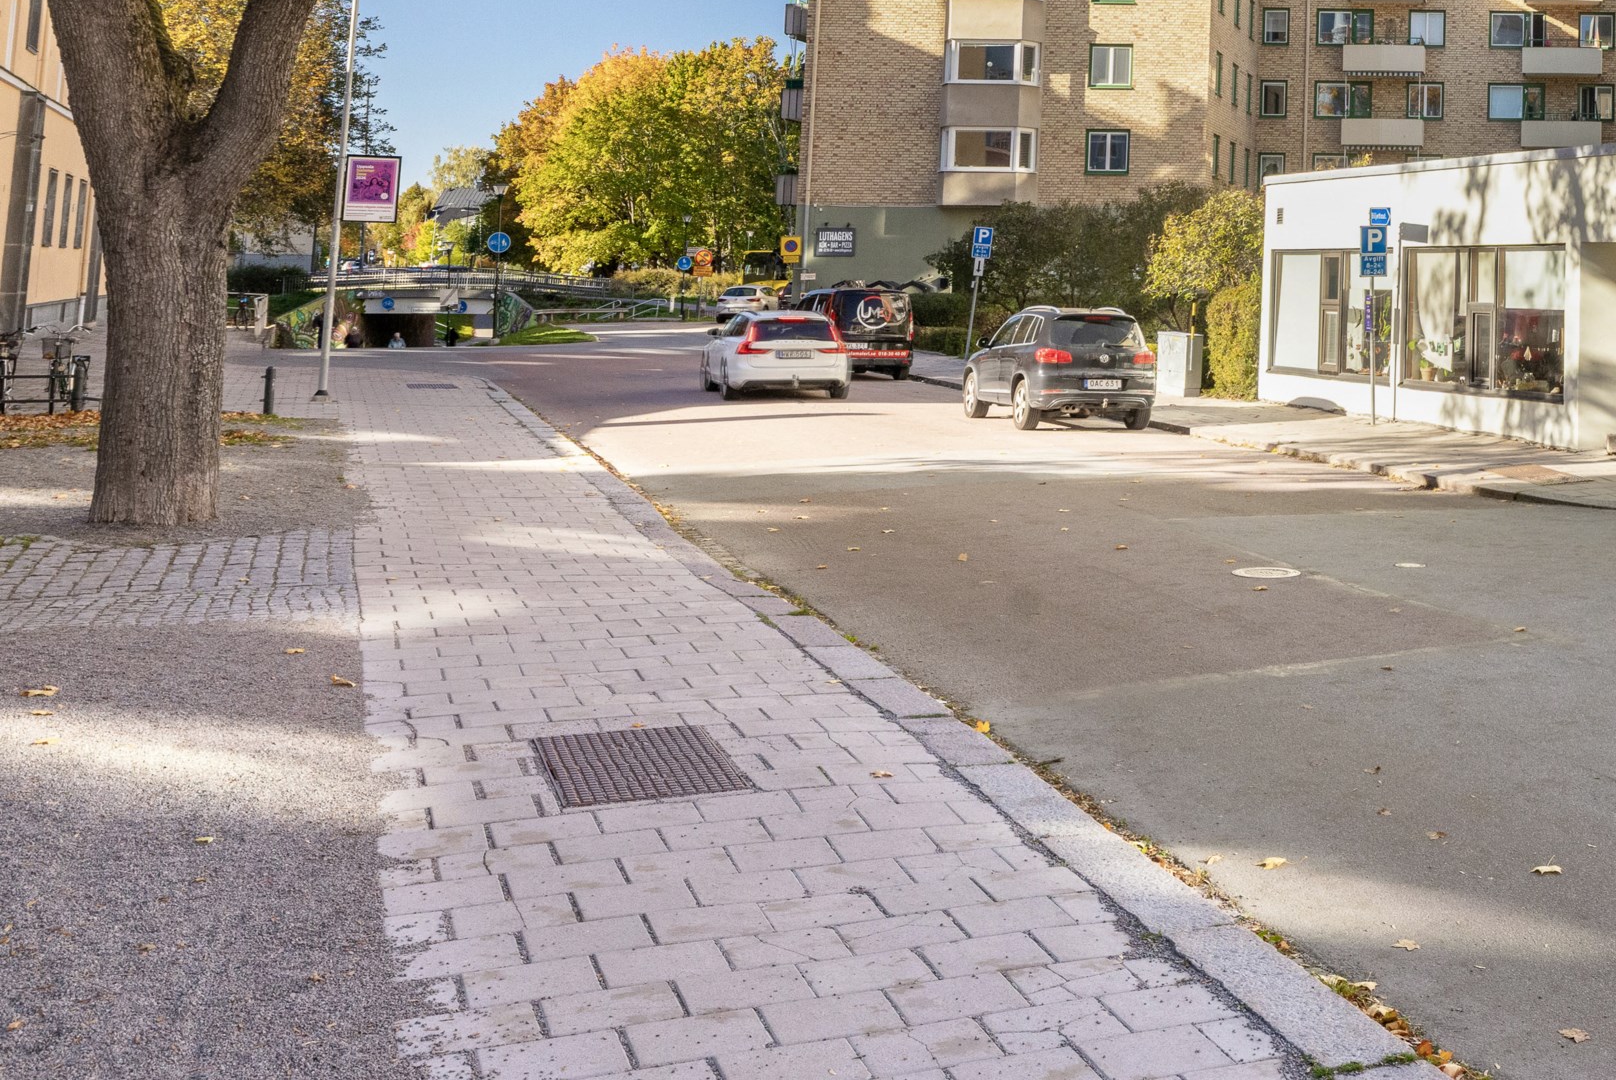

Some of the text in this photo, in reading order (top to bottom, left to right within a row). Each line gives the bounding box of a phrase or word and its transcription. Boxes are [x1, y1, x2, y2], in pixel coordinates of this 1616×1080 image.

[819, 231, 853, 241] LUTHAGENS
[978, 228, 990, 243] P
[1367, 228, 1383, 252] P
[830, 241, 839, 249] BAR
[841, 241, 852, 249] PIZZA
